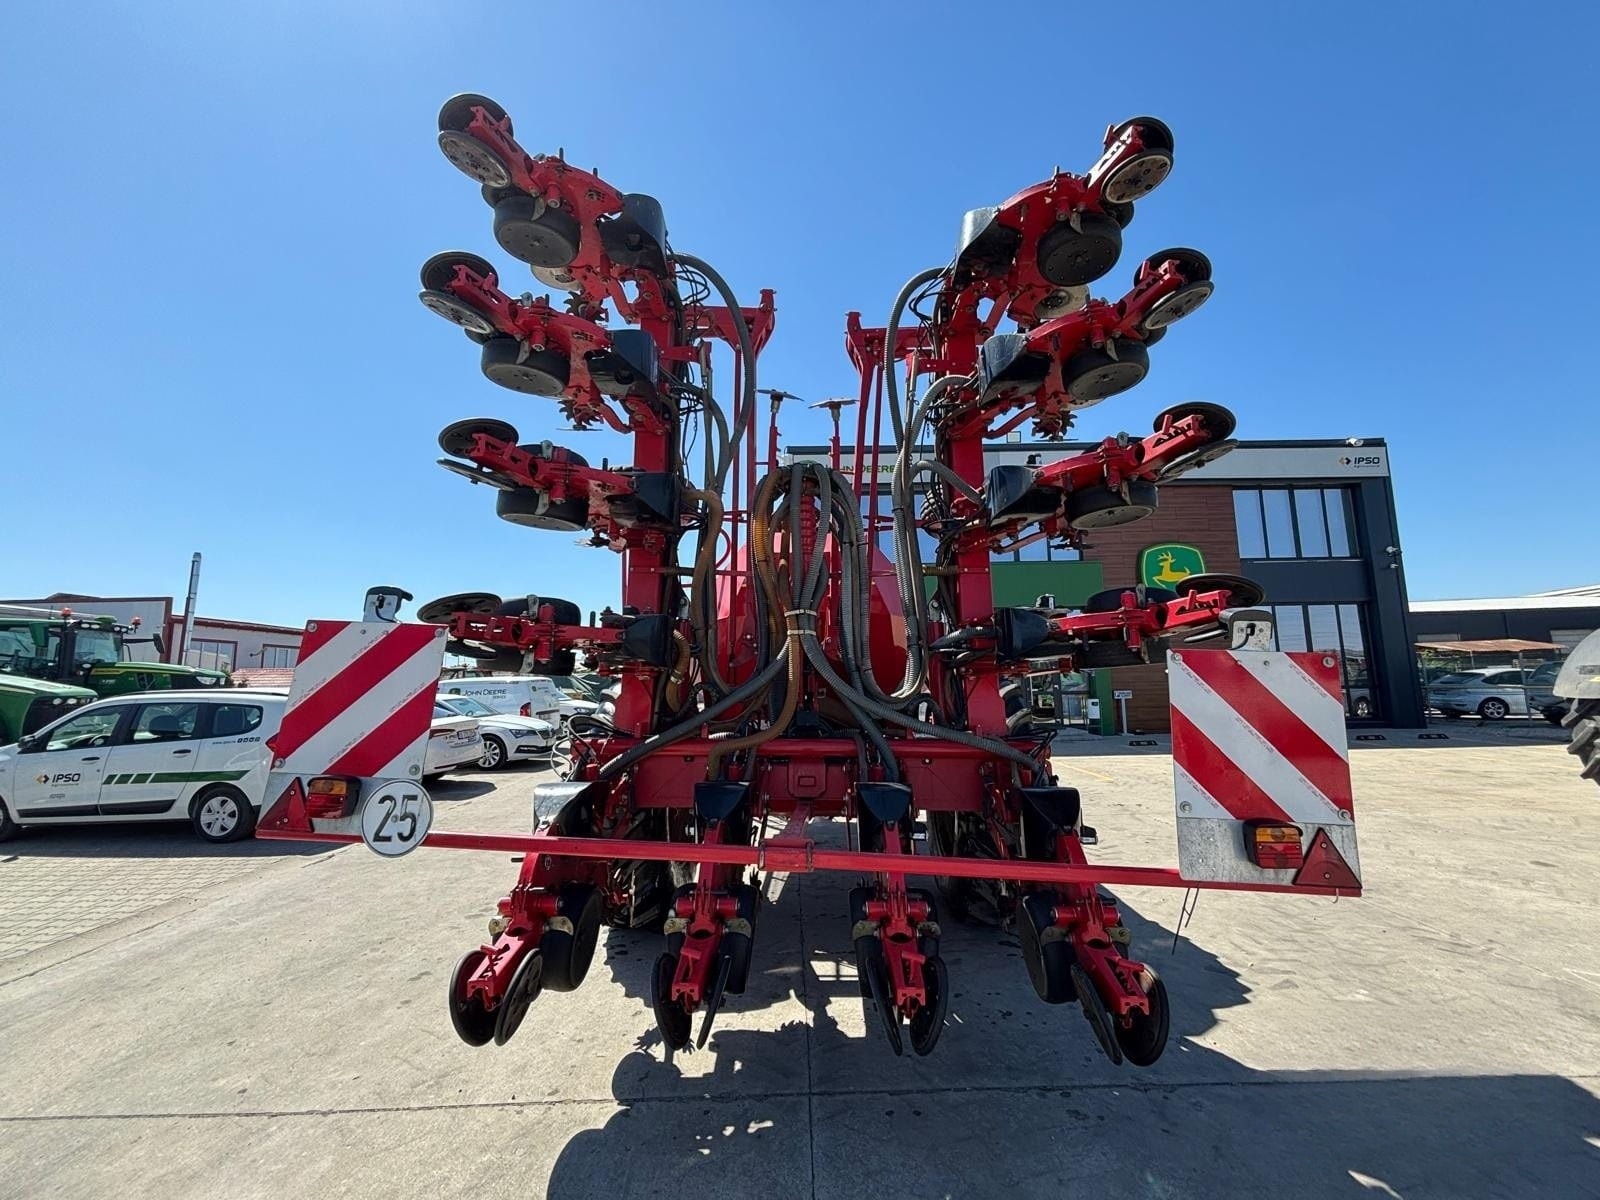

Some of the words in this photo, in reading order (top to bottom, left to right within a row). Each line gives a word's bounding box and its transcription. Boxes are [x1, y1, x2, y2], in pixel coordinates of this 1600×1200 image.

[1354, 456, 1380, 465] IPSO
[463, 689, 482, 697] JOHN
[482, 688, 507, 696] DEERE
[52, 772, 81, 783] IPSO
[373, 794, 419, 842] 25
